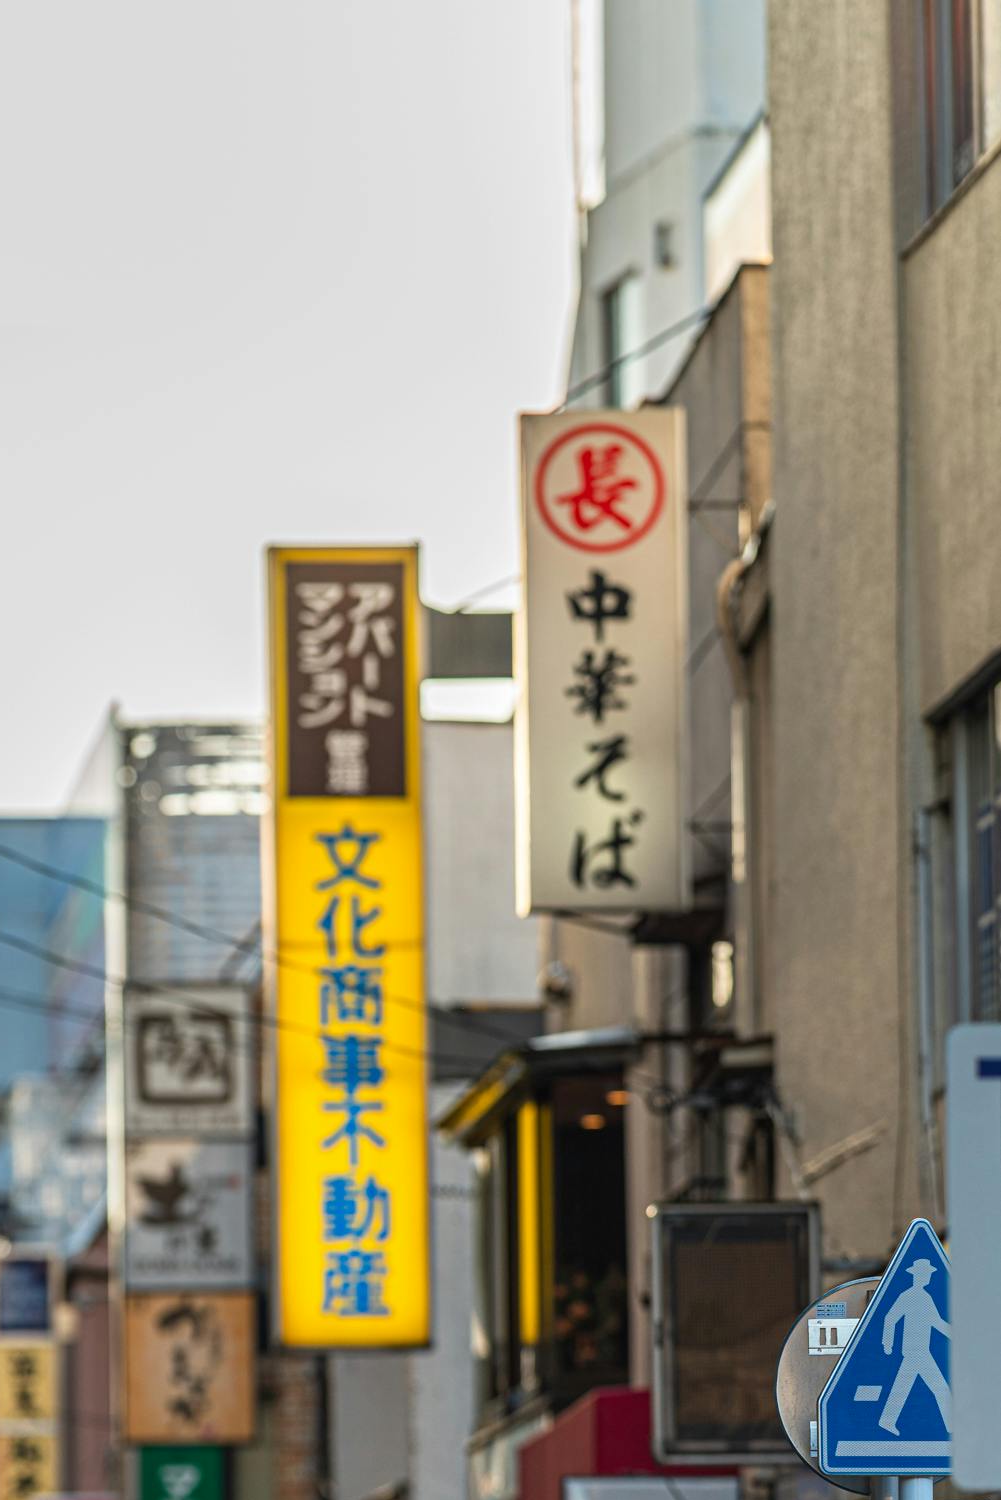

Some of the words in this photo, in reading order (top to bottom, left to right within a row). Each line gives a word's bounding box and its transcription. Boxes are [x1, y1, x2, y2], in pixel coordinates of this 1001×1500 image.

[565, 566, 645, 890] 中華そば
[312, 821, 391, 1318] 文化商事不動産
